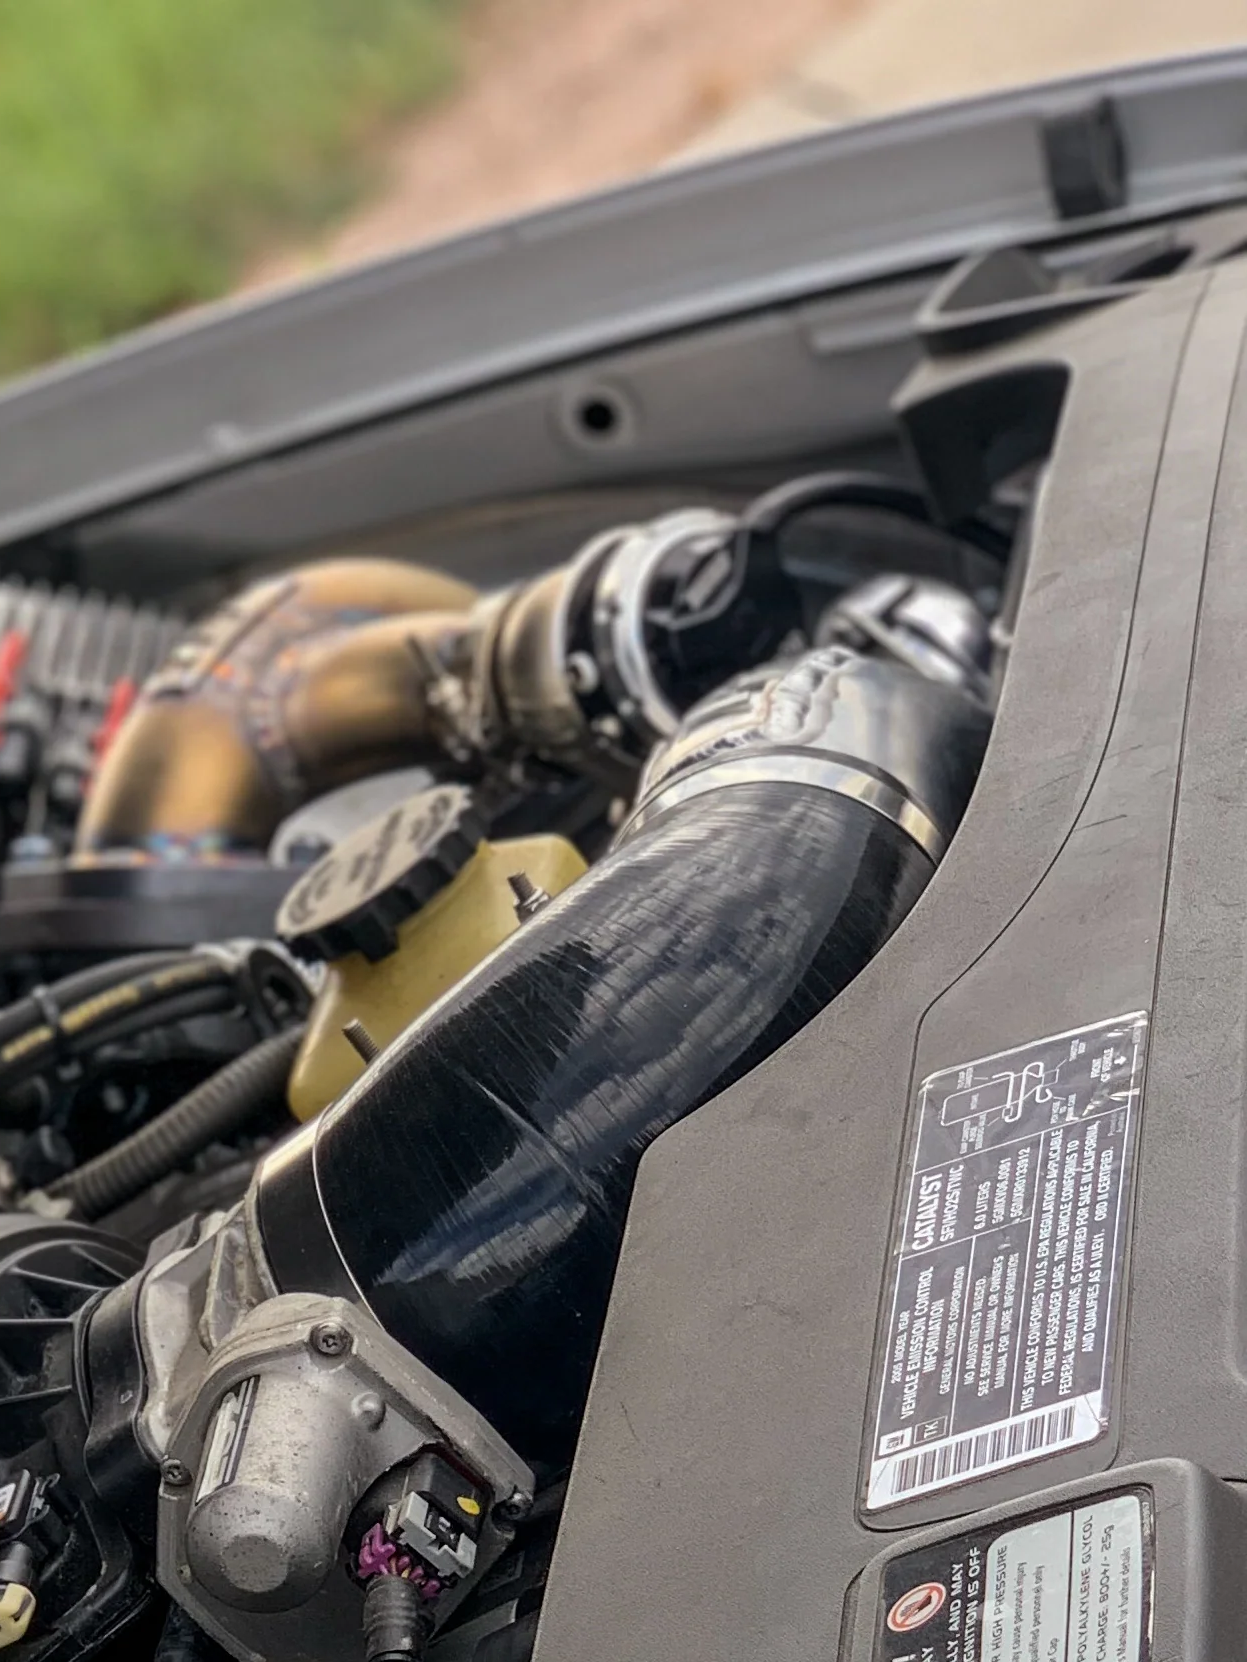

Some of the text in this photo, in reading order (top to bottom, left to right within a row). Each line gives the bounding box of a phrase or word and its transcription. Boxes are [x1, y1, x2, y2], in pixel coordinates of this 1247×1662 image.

[1045, 1127, 1063, 1180] APPLICABLE
[1080, 1171, 1094, 1184] IN
[911, 1169, 943, 1252] CATALYST
[973, 1180, 990, 1230] 6.0 LITERS
[1038, 1178, 1057, 1239] REGULATIONS
[1078, 1182, 1093, 1207] SALE
[1094, 1199, 1108, 1222] OBD
[1076, 1204, 1090, 1227] FOR
[1036, 1238, 1050, 1258] EPA
[1040, 1138, 1079, 1385] TO NEW PASSENGER CARS. THIS VEHICLE CONFORMS TO
[1071, 1224, 1088, 1273] CERTIFIED
[1089, 1259, 1102, 1270] A
[1032, 1276, 1046, 1292] TO
[1034, 1257, 1048, 1278] U.S.
[1069, 1271, 1083, 1284] IS
[1087, 1268, 1101, 1284] AS
[988, 1292, 999, 1306] OR
[1082, 1282, 1100, 1332] QUALIFIES
[897, 1309, 910, 1332] YEAR
[939, 1265, 964, 1395] GENERAL MOTORS CORPORATION
[984, 1306, 997, 1341] MANUAL
[993, 1251, 1019, 1389] MANUAL FOR MORE INFORMATION
[1026, 1291, 1044, 1346] CONFORMS
[893, 1331, 907, 1362] MODEL
[900, 1265, 933, 1419] VEHICLE EMISSION CONTROL
[922, 1298, 944, 1374] INFORMATION
[965, 1310, 982, 1371] ADJUSTMENTS
[1080, 1330, 1095, 1355] AND
[980, 1340, 993, 1377] SERVICE
[1022, 1345, 1038, 1387] VEHICLE
[1057, 1350, 1075, 1396] FEDERAL
[963, 1369, 975, 1385] NO
[977, 1377, 989, 1397] SEE
[1019, 1385, 1034, 1411] THIS
[923, 1420, 938, 1438] TK
[1081, 1514, 1093, 1564] GLYCOL
[1101, 1523, 1114, 1552] 25g
[967, 1544, 982, 1578] OFF
[1014, 1560, 1027, 1587] injury
[1032, 1564, 1044, 1585] only
[1119, 1545, 1131, 1576] details
[950, 1560, 965, 1596] MAY
[966, 1579, 979, 1597] IS
[992, 1544, 1008, 1615] PRESSURE
[1117, 1575, 1129, 1607] further
[947, 1597, 962, 1633] AND
[1011, 1587, 1025, 1625] personal
[1029, 1584, 1043, 1628] personnel
[1075, 1567, 1090, 1662] POLYALKYLENE
[1117, 1607, 1128, 1622] for
[990, 1617, 1003, 1651] HIGH
[1010, 1624, 1022, 1651] cause
[1046, 1636, 1059, 1656] Cap
[1115, 1621, 1127, 1656] Manual
